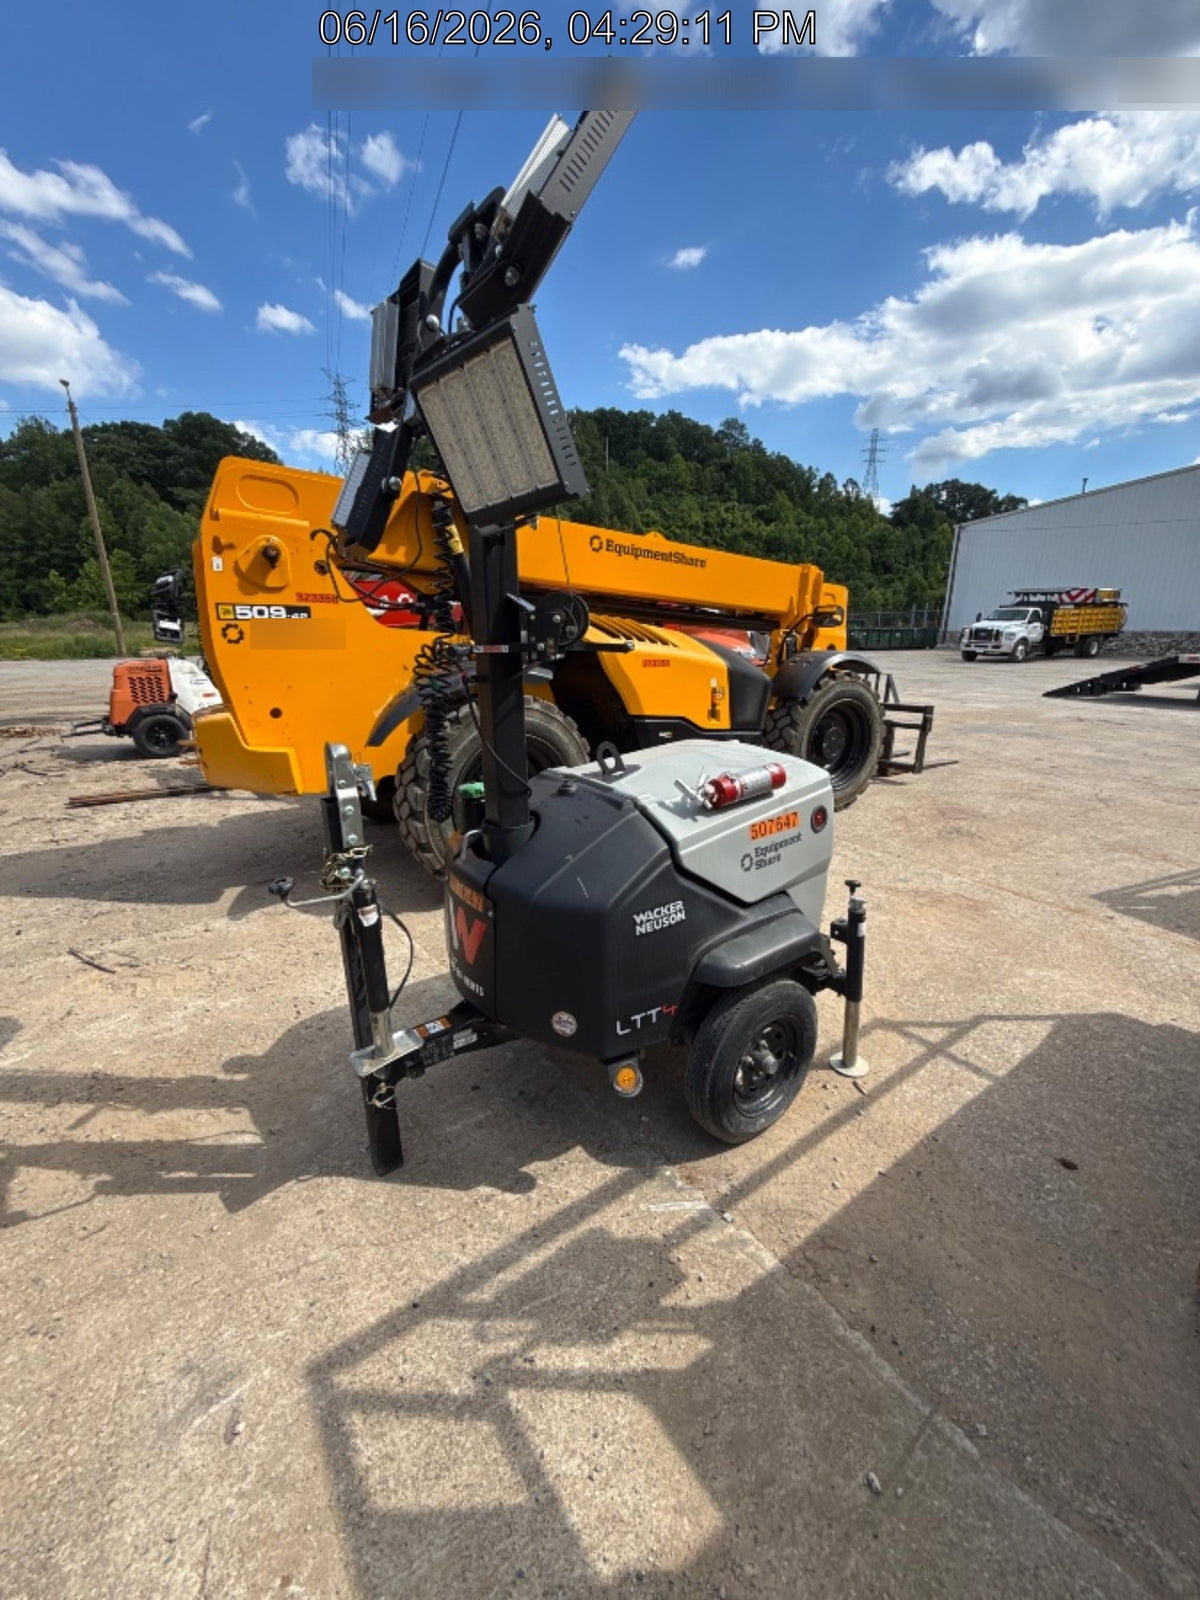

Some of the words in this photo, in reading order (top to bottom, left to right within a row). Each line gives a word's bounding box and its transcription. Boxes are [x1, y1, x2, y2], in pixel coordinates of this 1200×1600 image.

[606, 539, 707, 568] EquipmentShare
[751, 812, 798, 840] 507647
[755, 832, 802, 857] Equipment
[755, 854, 781, 870] Share
[633, 900, 684, 924] WACKER
[635, 910, 687, 936] NEUSON
